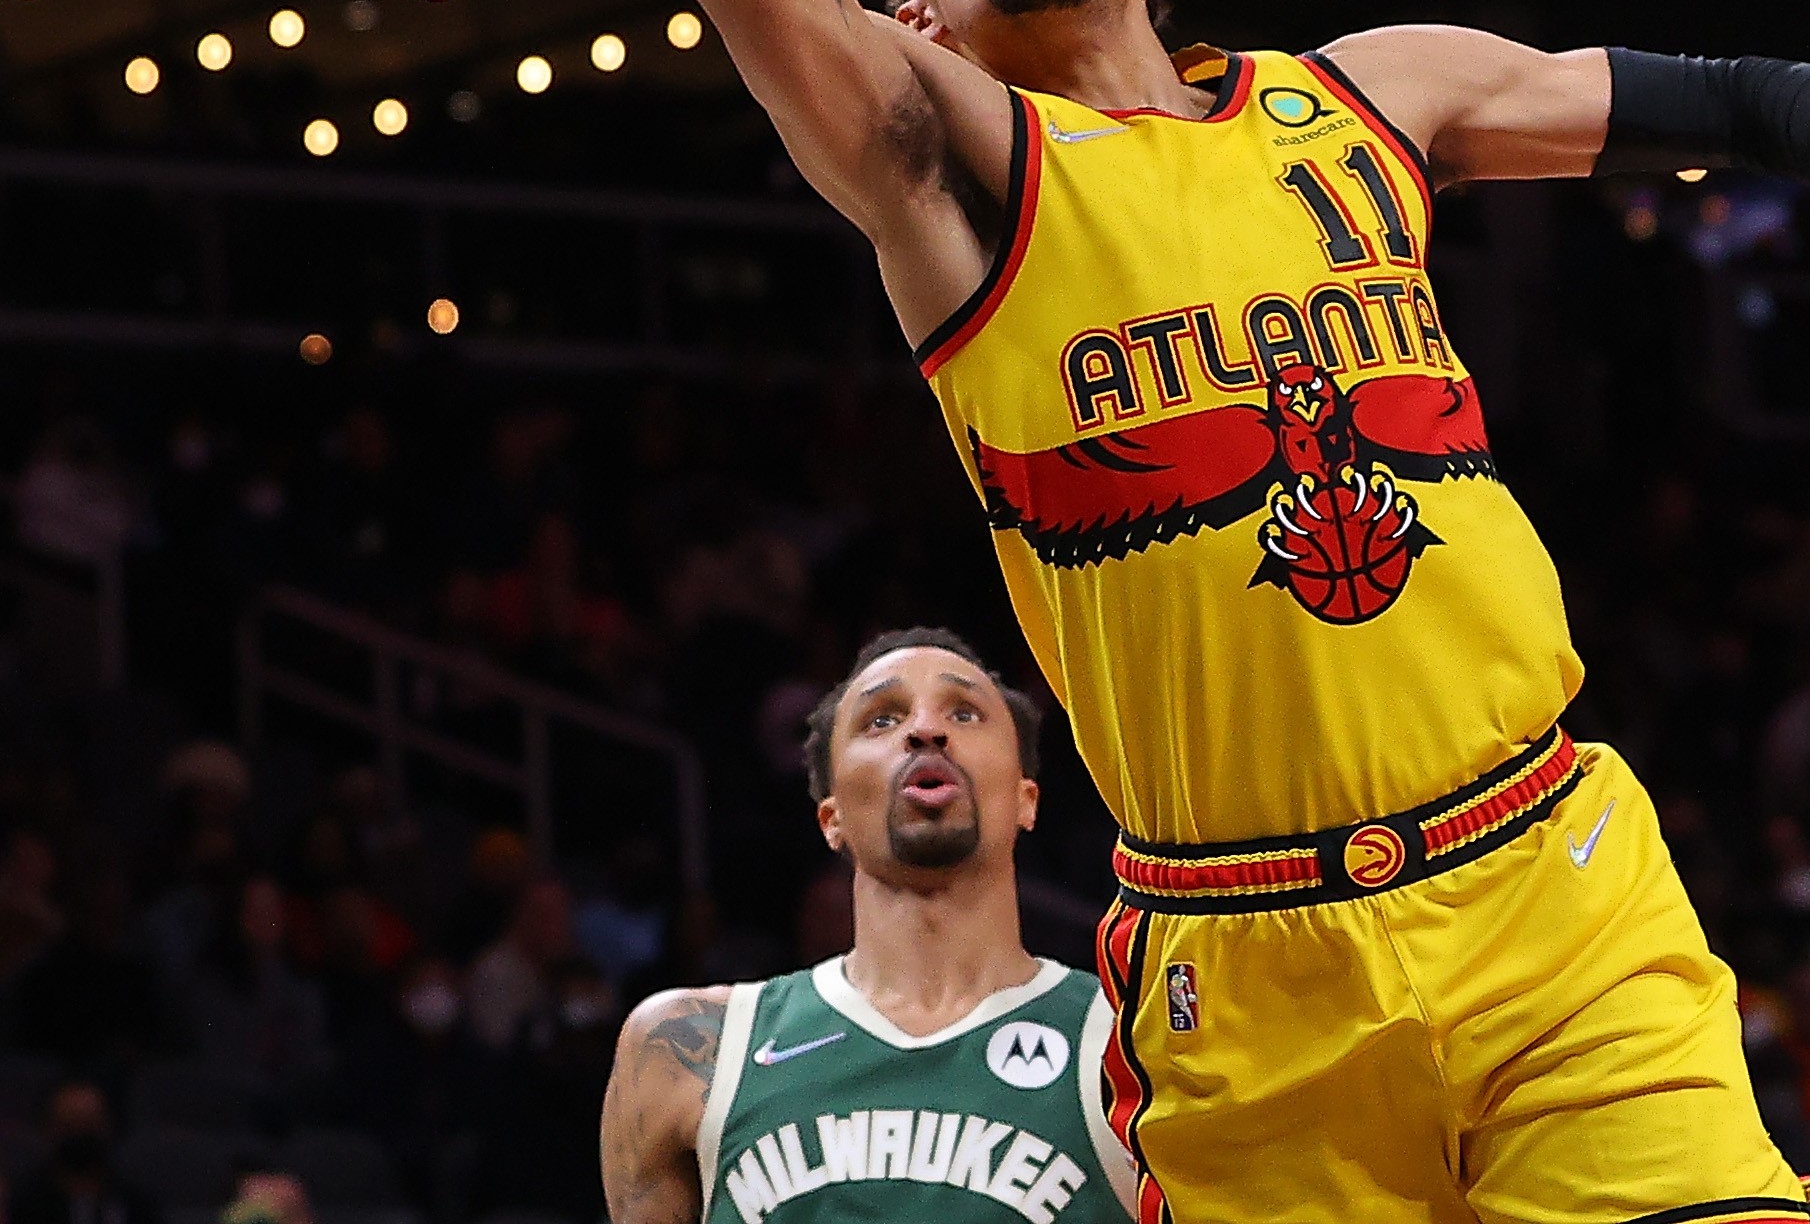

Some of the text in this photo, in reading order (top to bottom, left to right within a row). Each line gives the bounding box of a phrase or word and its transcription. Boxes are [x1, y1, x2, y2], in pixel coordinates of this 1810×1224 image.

[1271, 116, 1357, 148] sharecare
[1275, 139, 1424, 273] 11
[1059, 275, 1456, 433] ATLANTA
[724, 1109, 1089, 1224] MILWAUKEE
